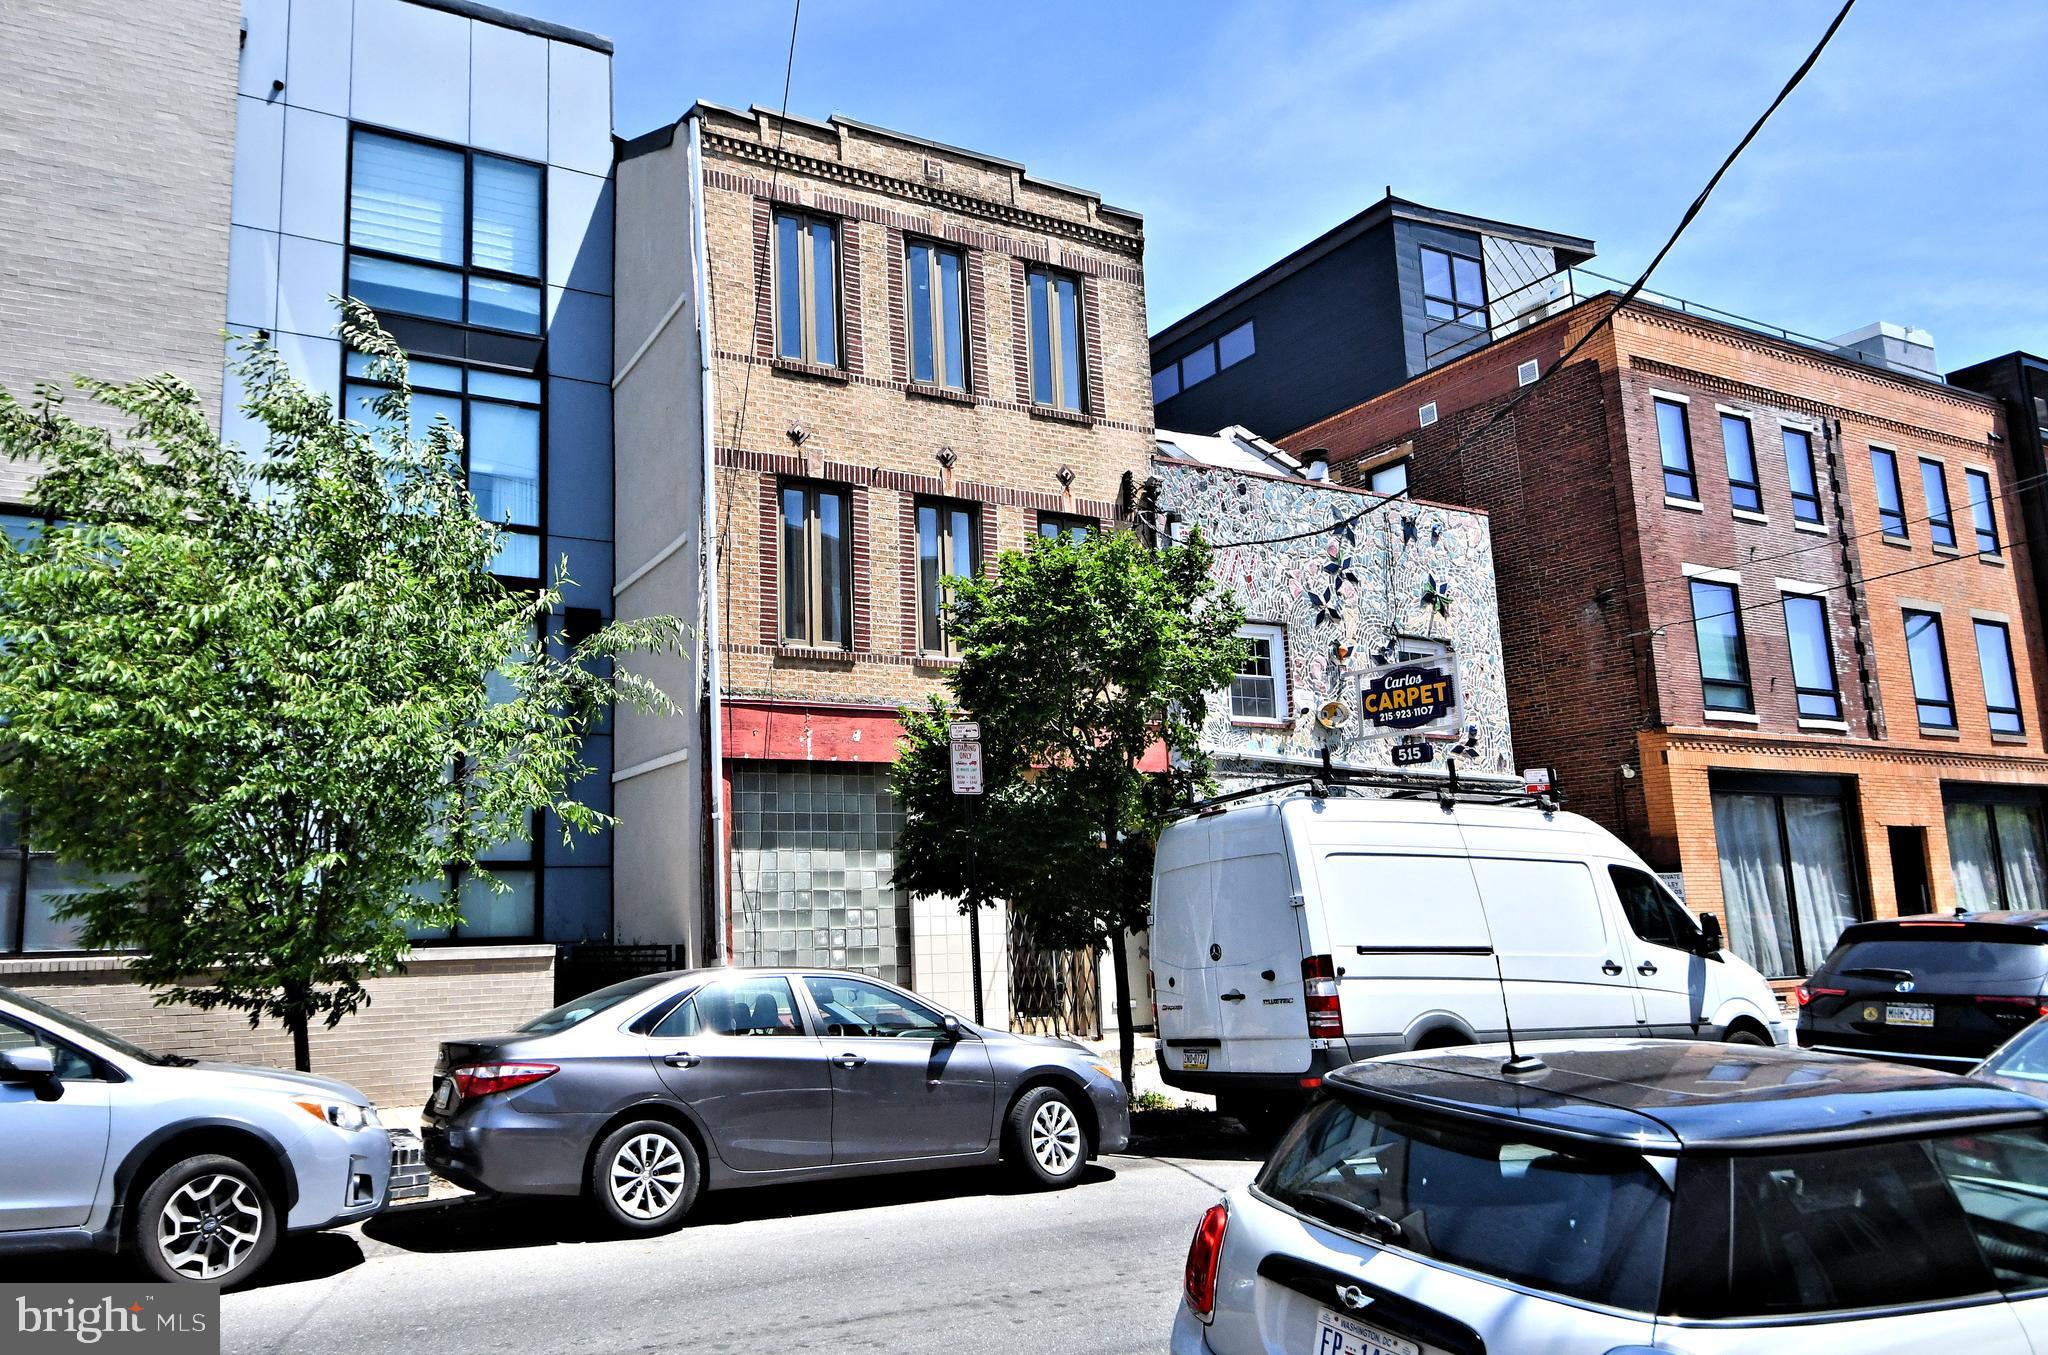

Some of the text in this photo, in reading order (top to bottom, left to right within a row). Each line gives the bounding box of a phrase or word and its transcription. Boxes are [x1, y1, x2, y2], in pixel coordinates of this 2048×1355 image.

[1385, 674, 1423, 689] Carlos
[1365, 681, 1447, 713] CARPET
[1398, 747, 1422, 761] 515
[1382, 1336, 1392, 1348] DC
